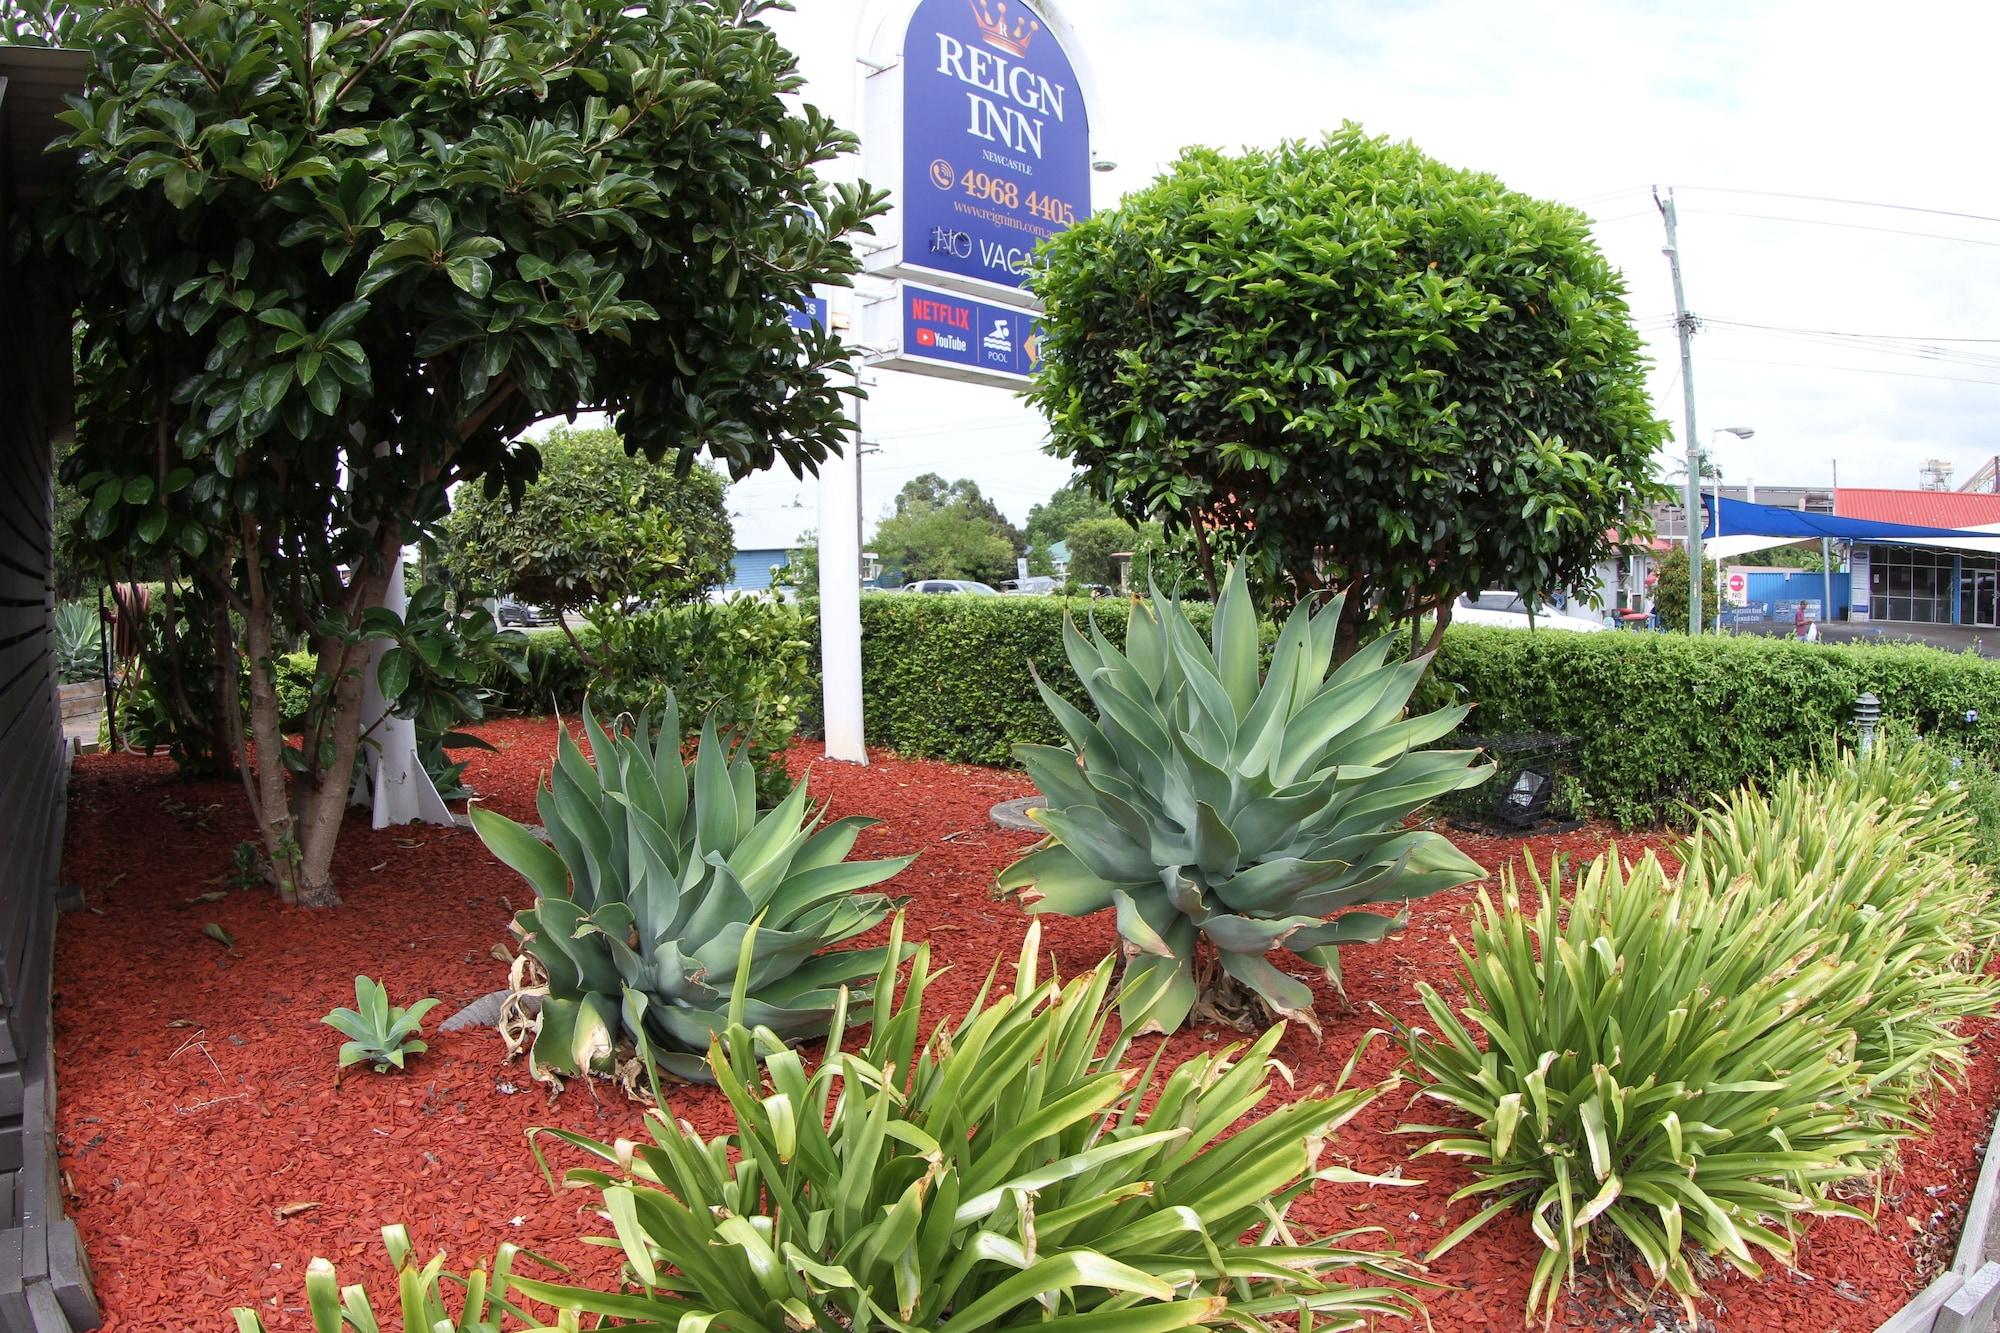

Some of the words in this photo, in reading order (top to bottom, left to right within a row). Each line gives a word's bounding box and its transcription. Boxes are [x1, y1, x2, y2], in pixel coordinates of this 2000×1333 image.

[999, 23, 1009, 38] R
[936, 32, 1065, 123] REIGN
[966, 92, 1044, 160] INN
[982, 149, 1033, 176] NEWCASTLE
[960, 169, 1019, 209] 4968
[1025, 191, 1075, 226] 4405
[953, 201, 1056, 239] www.reigninn.com.a
[912, 297, 970, 330] NETFLIX
[934, 332, 967, 352] YouTube
[988, 351, 1008, 364] POOL
